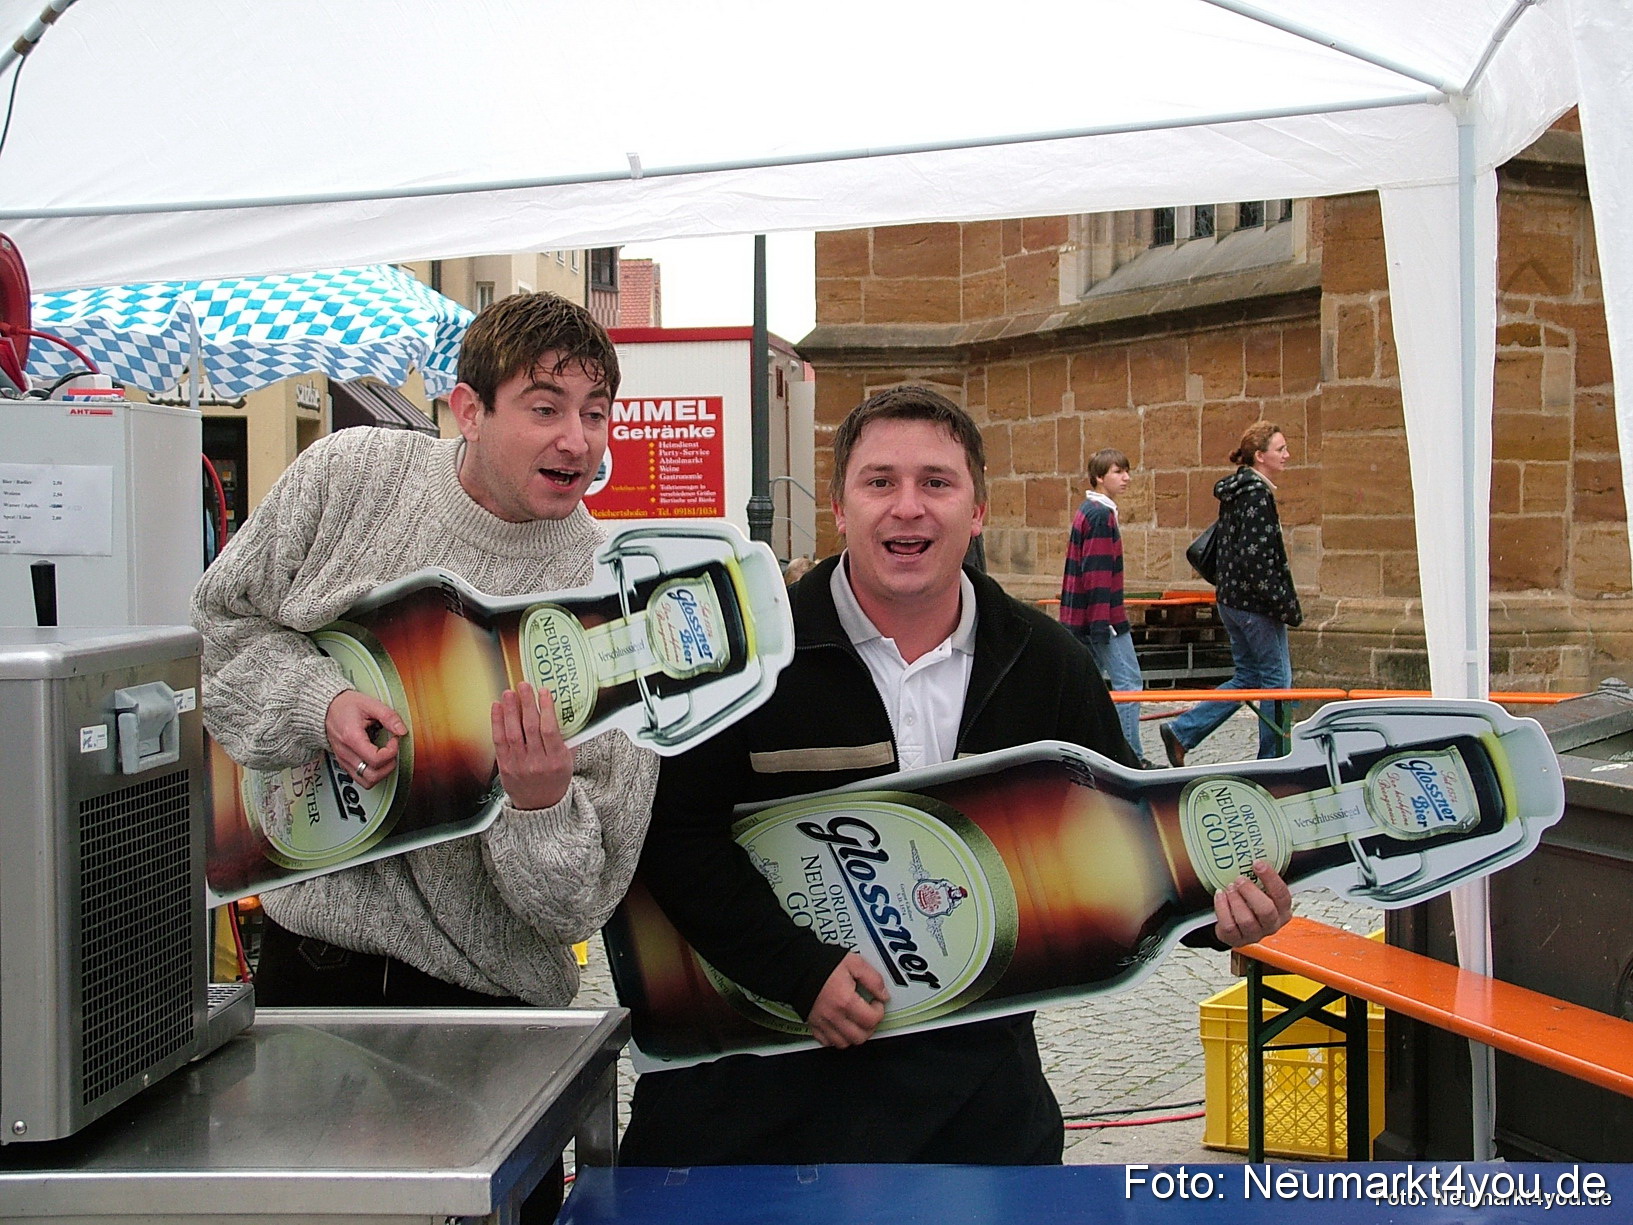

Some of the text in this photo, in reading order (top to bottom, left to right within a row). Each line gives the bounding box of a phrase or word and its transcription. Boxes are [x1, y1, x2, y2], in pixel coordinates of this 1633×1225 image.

[612, 400, 717, 422] MMEL
[612, 424, 716, 440] Getränke
[659, 441, 699, 449] Heimdienst
[659, 449, 710, 457] Party-Service
[659, 457, 703, 465] Abholmarkt
[667, 588, 713, 660] Glossner
[679, 628, 693, 665] Bier
[540, 616, 575, 726] NEUMARKTER
[560, 635, 581, 700] ORIGINAL
[303, 762, 320, 827] RKTER
[1395, 759, 1458, 822] Glossner
[1411, 795, 1428, 828] Bier
[1201, 813, 1235, 870] GOLD
[787, 892, 814, 928] GO
[797, 816, 941, 990] Glossner
[801, 853, 840, 944] NEUMAR
